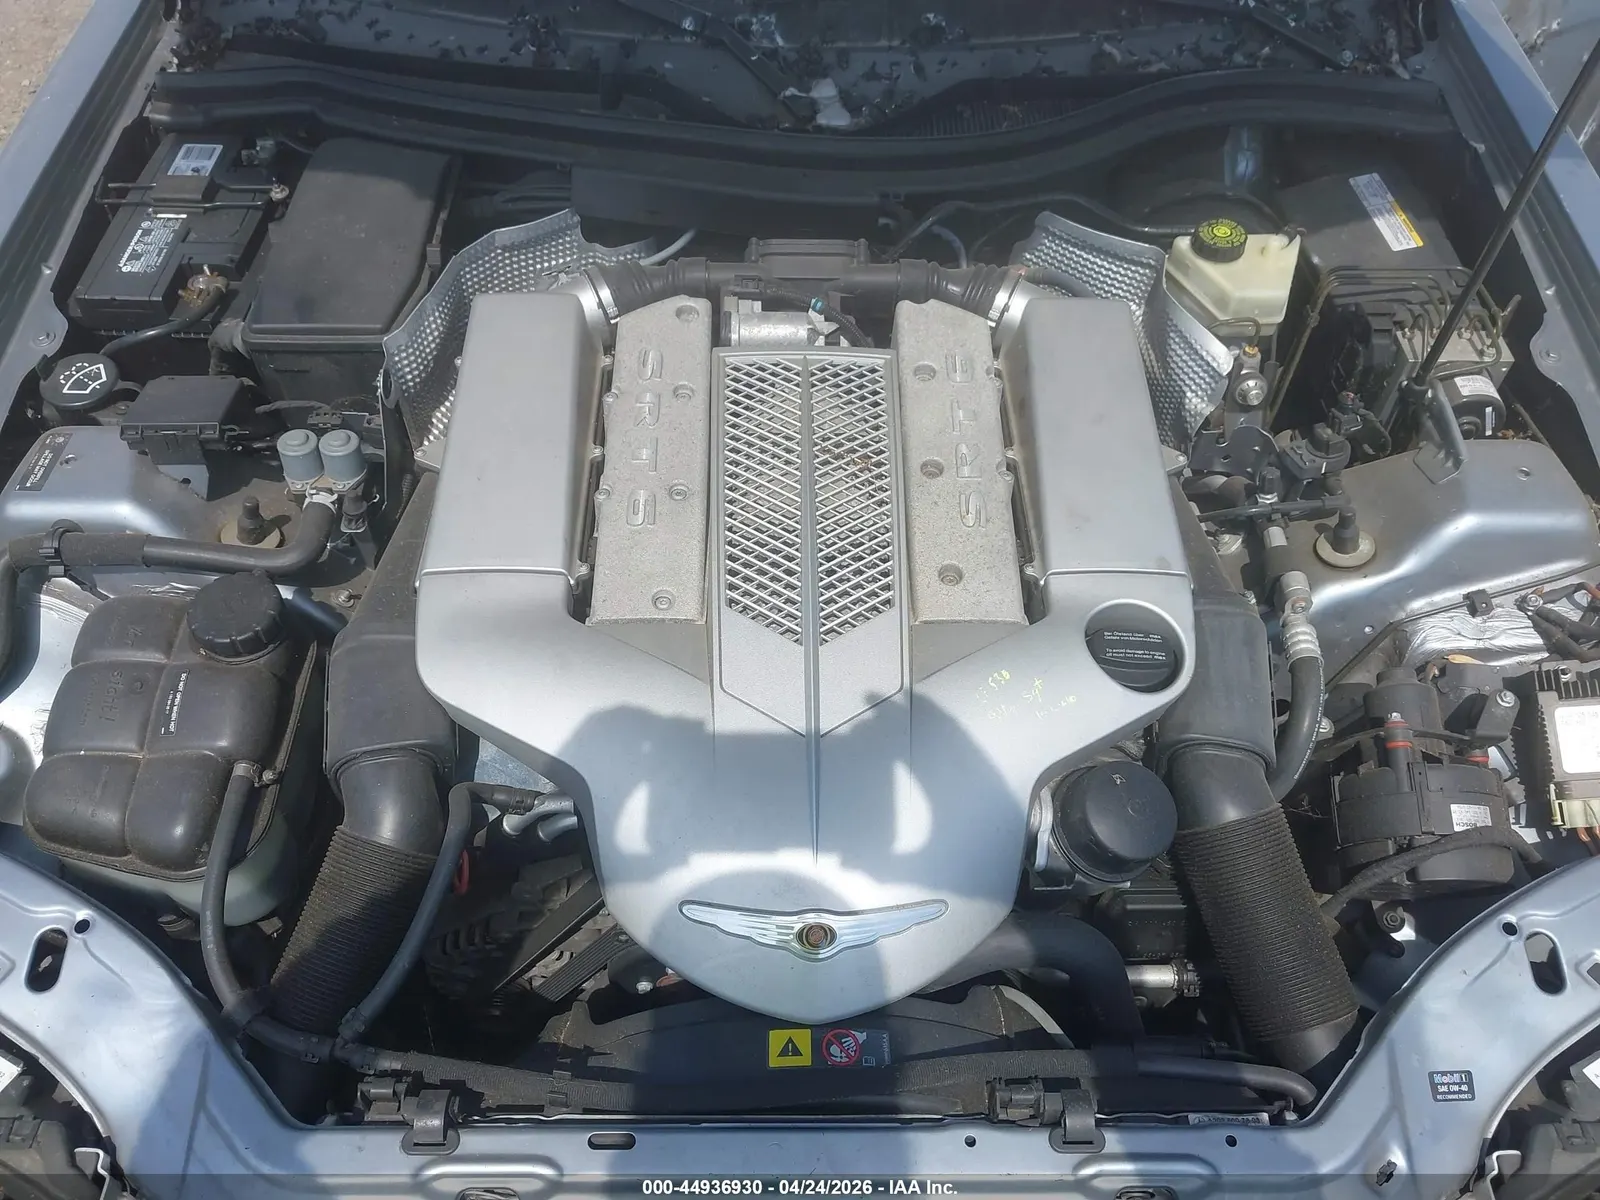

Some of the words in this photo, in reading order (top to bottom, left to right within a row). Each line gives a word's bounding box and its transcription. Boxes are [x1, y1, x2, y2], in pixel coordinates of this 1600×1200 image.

[177, 681, 185, 691] NOT
[174, 691, 182, 706] OPEN
[170, 705, 178, 721] WHEN
[168, 721, 176, 732] HOT
[1433, 1073, 1461, 1083] Mobil
[1449, 1084, 1469, 1092] 0W-40
